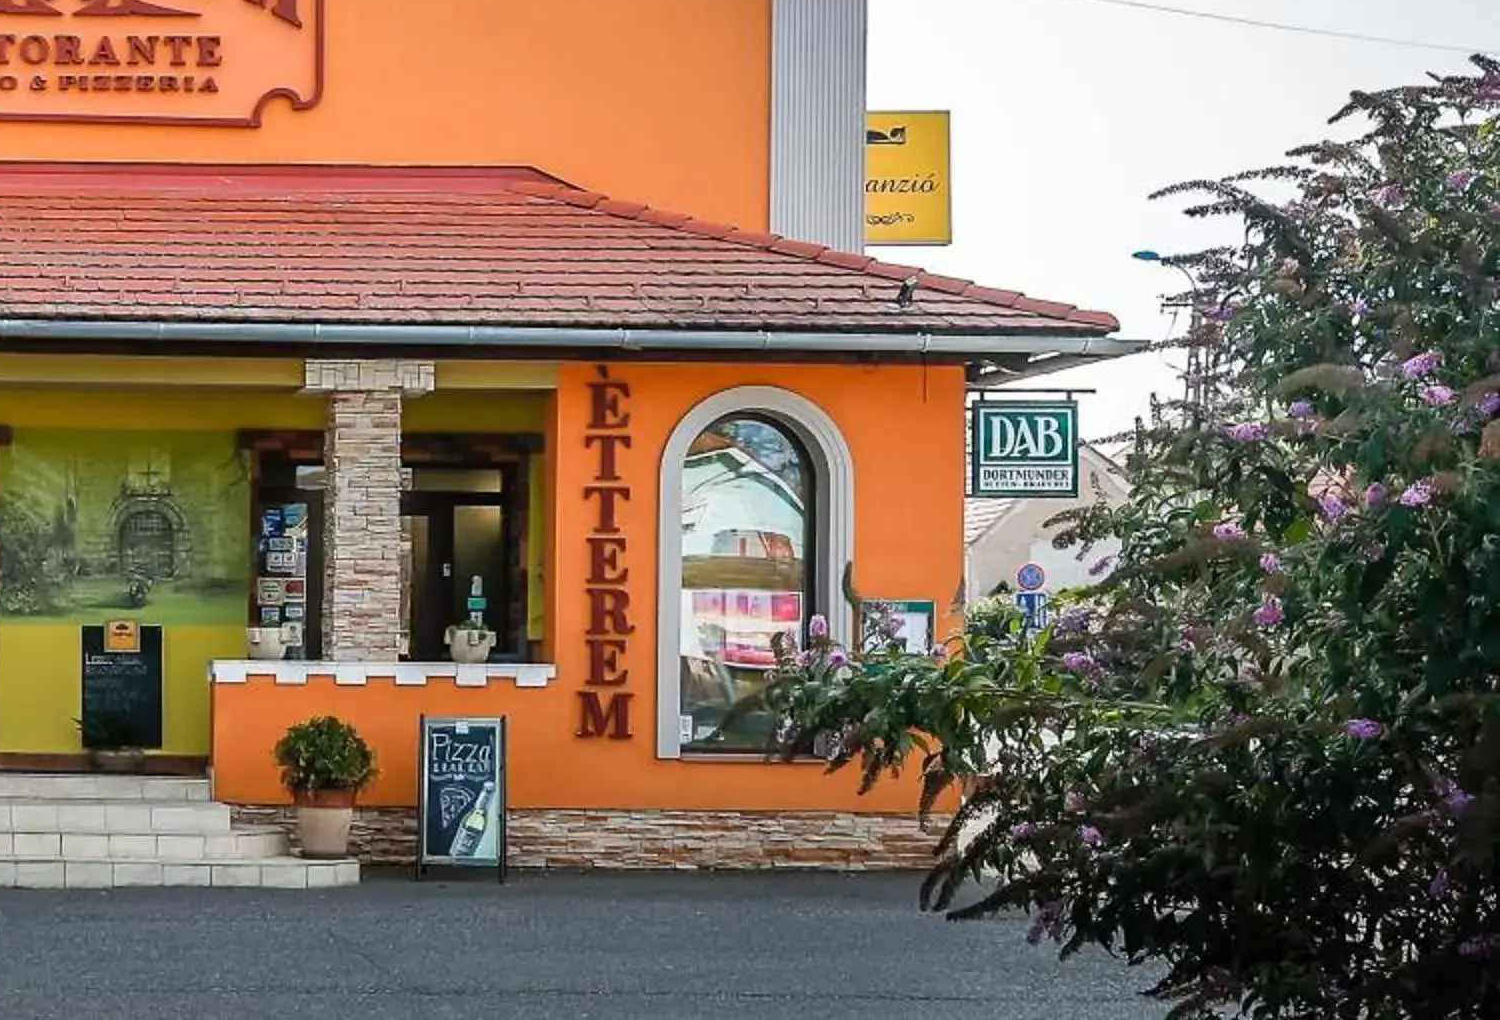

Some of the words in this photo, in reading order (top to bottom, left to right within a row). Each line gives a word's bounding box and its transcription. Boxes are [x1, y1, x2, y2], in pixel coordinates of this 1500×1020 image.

[29, 74, 48, 92] &
[58, 75, 219, 93] PIZZERIA
[865, 172, 940, 193] anzió
[989, 416, 1063, 457] DAB
[983, 469, 1069, 480] DORTMUNDER
